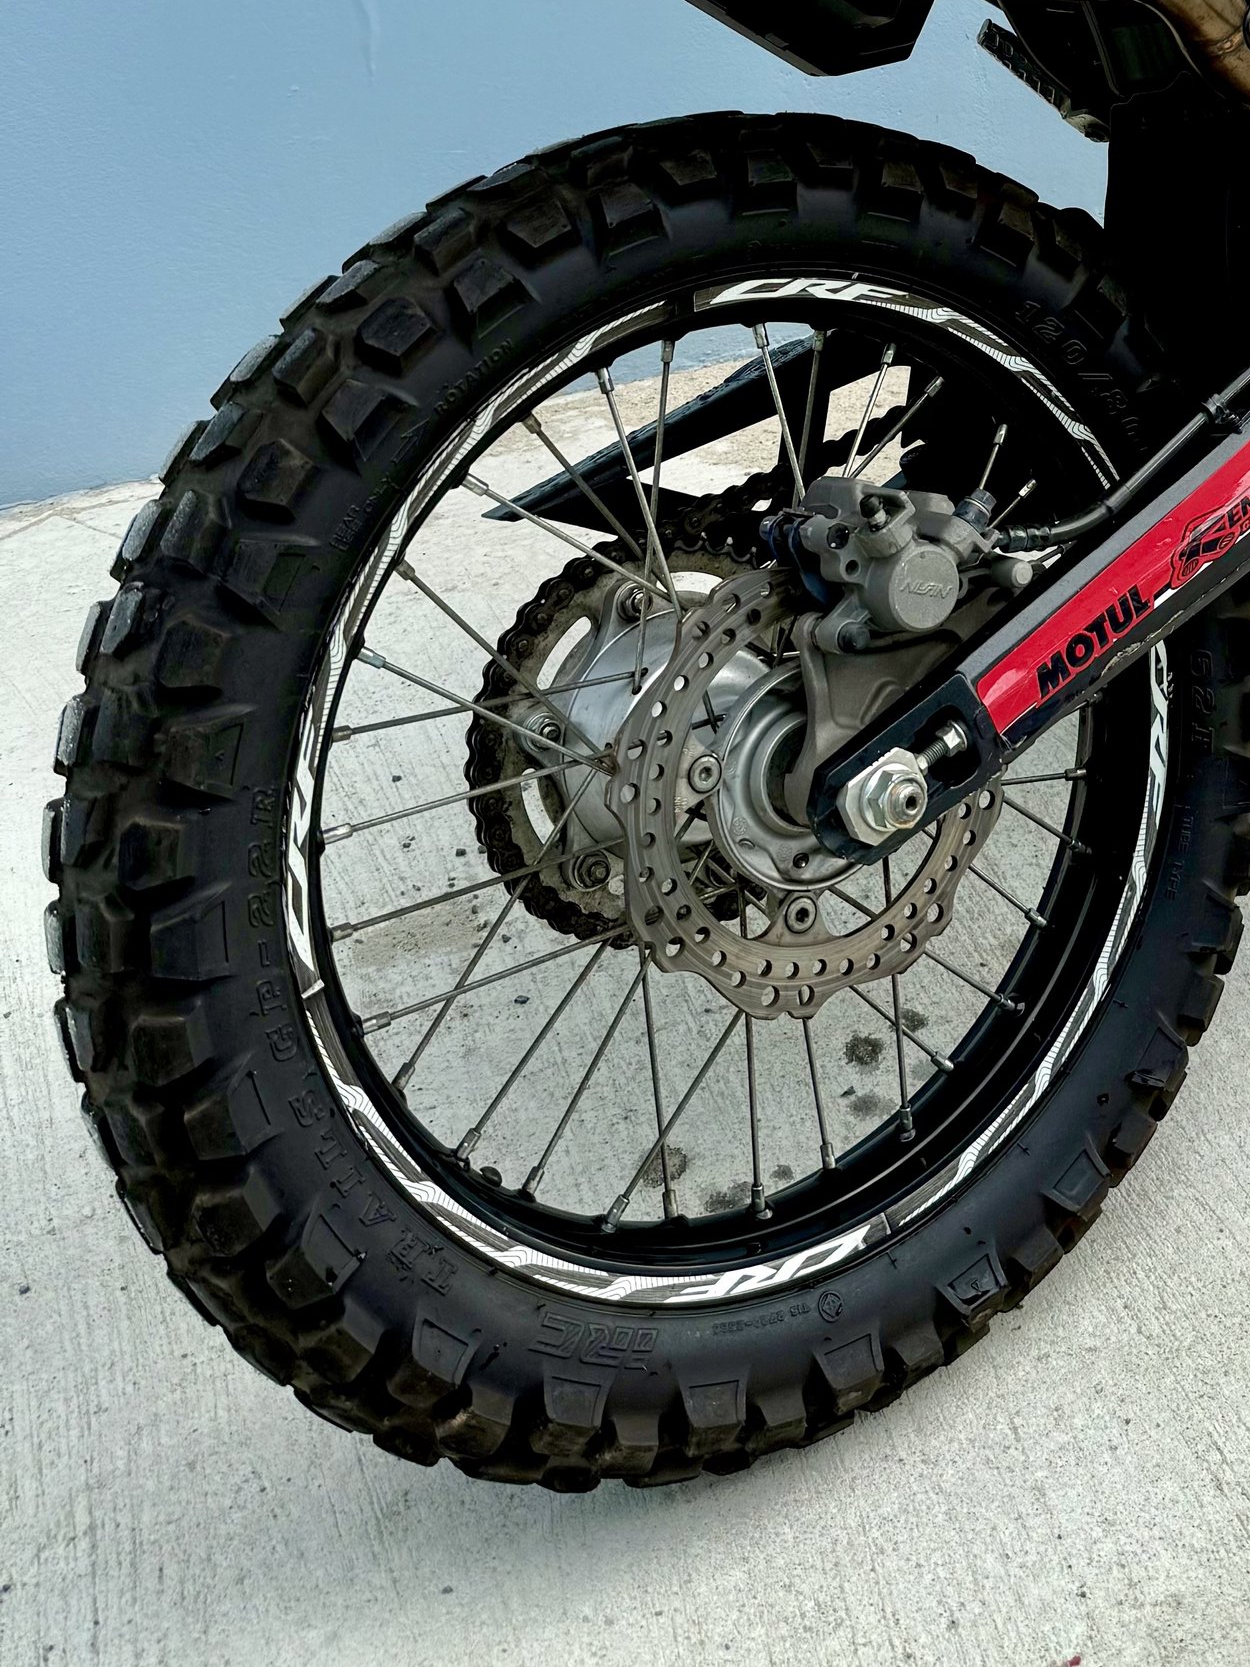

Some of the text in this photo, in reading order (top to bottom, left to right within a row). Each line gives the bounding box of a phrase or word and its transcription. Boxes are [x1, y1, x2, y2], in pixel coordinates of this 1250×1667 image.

[709, 277, 908, 305] CRF
[1035, 586, 1156, 700] MOTUL
[246, 785, 459, 1297] TRAILS GP-22R
[664, 1225, 870, 1302] CRF
